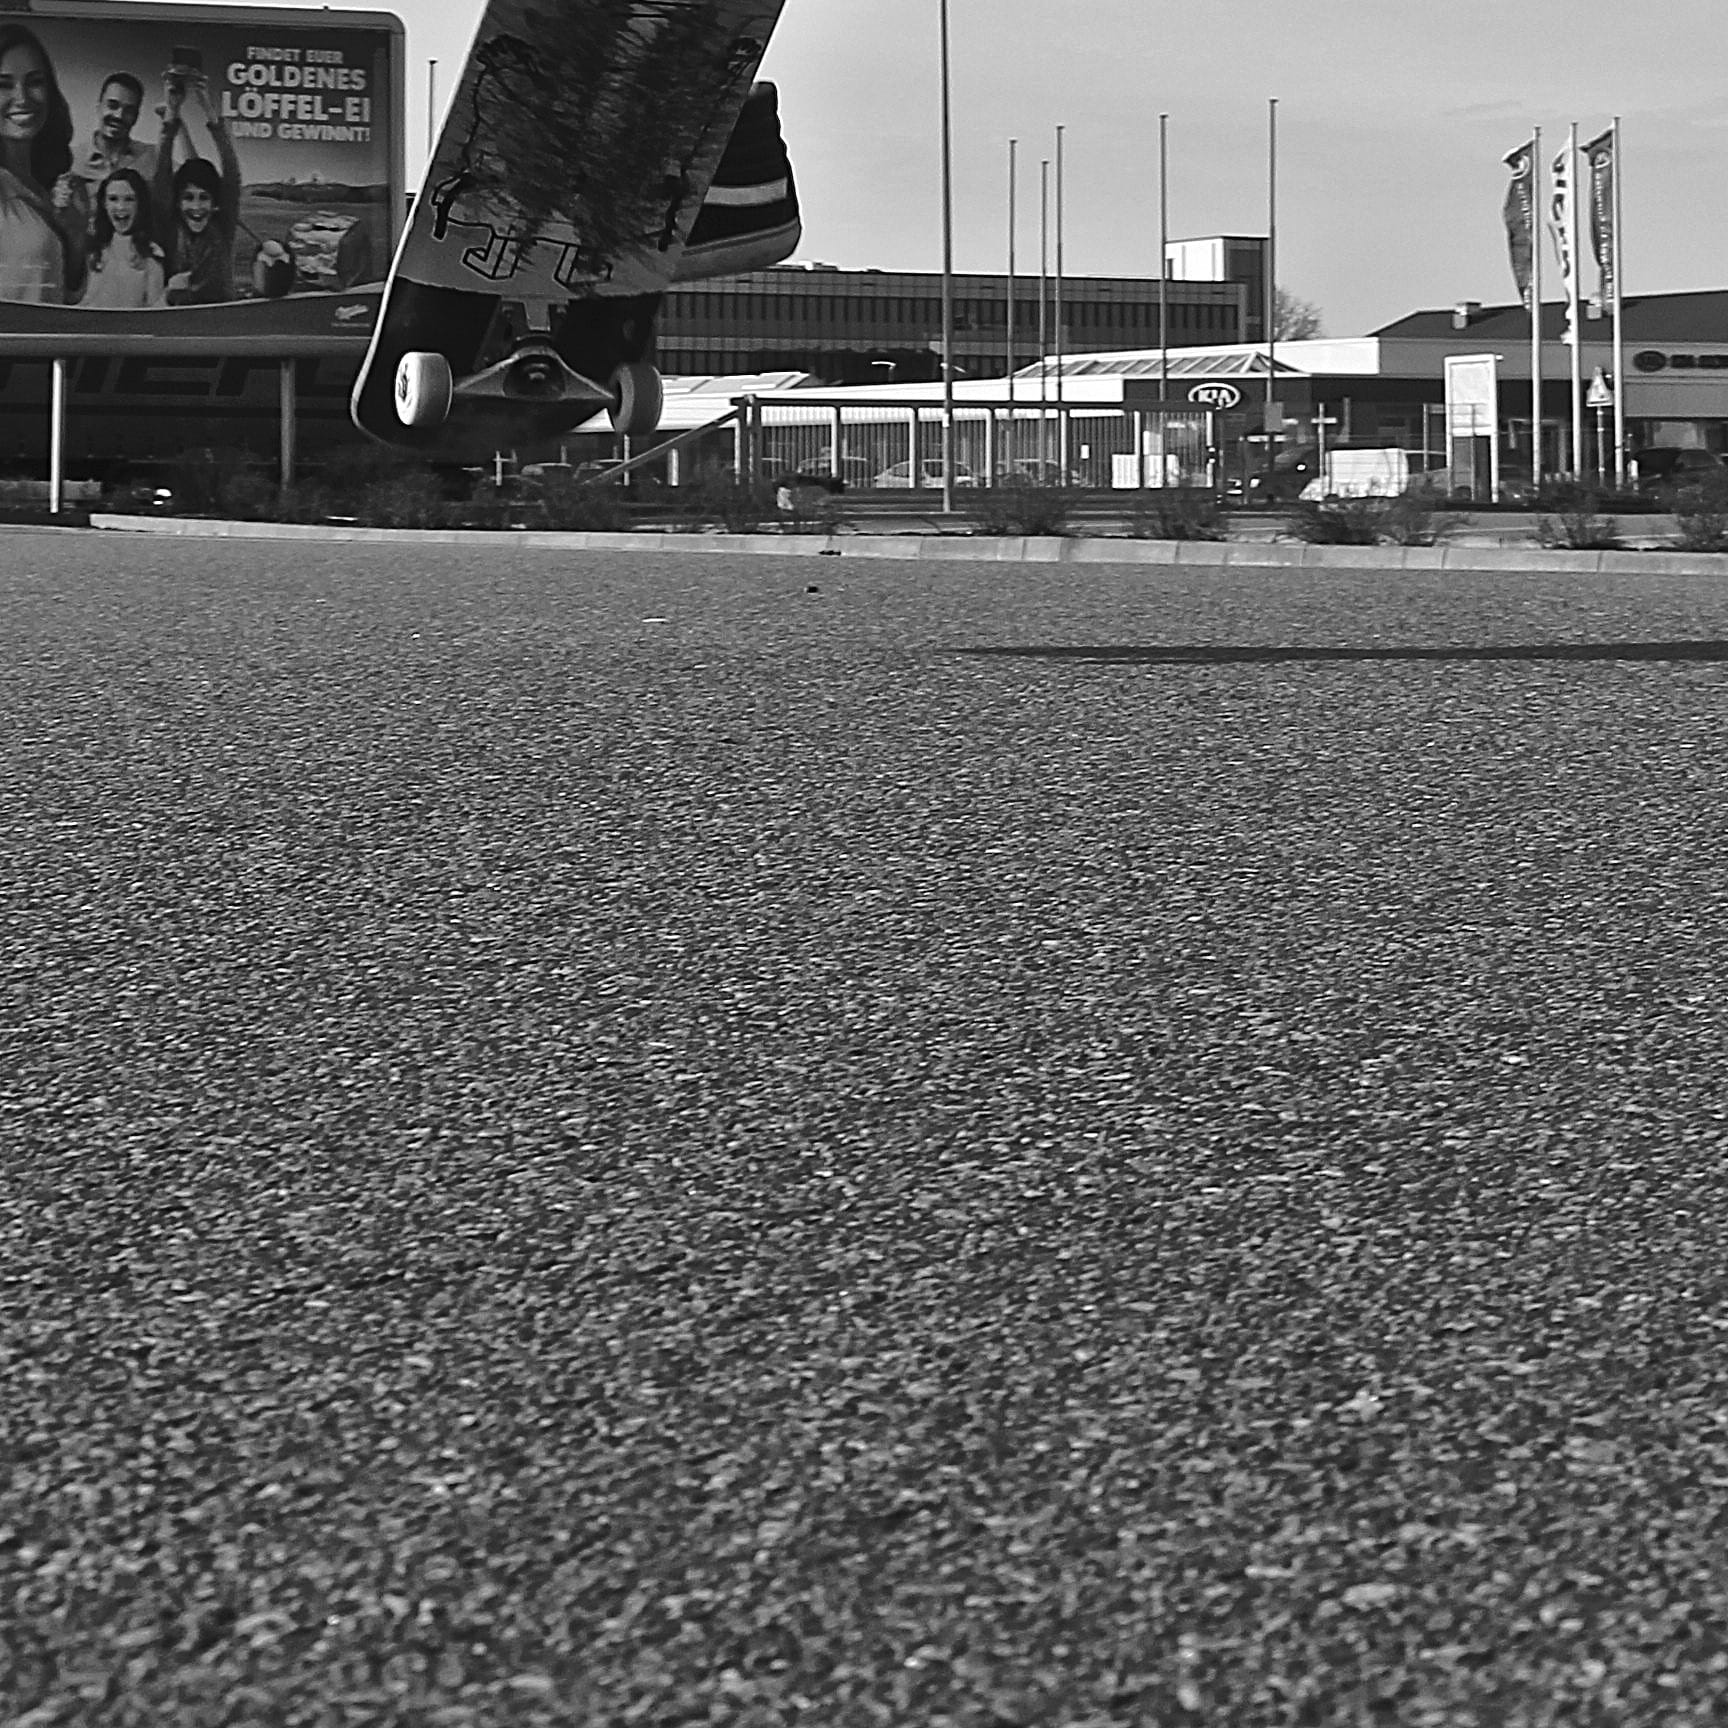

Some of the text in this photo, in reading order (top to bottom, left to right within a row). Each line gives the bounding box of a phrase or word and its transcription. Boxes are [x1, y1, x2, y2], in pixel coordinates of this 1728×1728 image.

[247, 46, 344, 64] FINDET EUER
[228, 63, 366, 90] GOLDENES
[222, 87, 370, 122] LÖFFEL-EI
[232, 122, 370, 141] UND GEWINNT!
